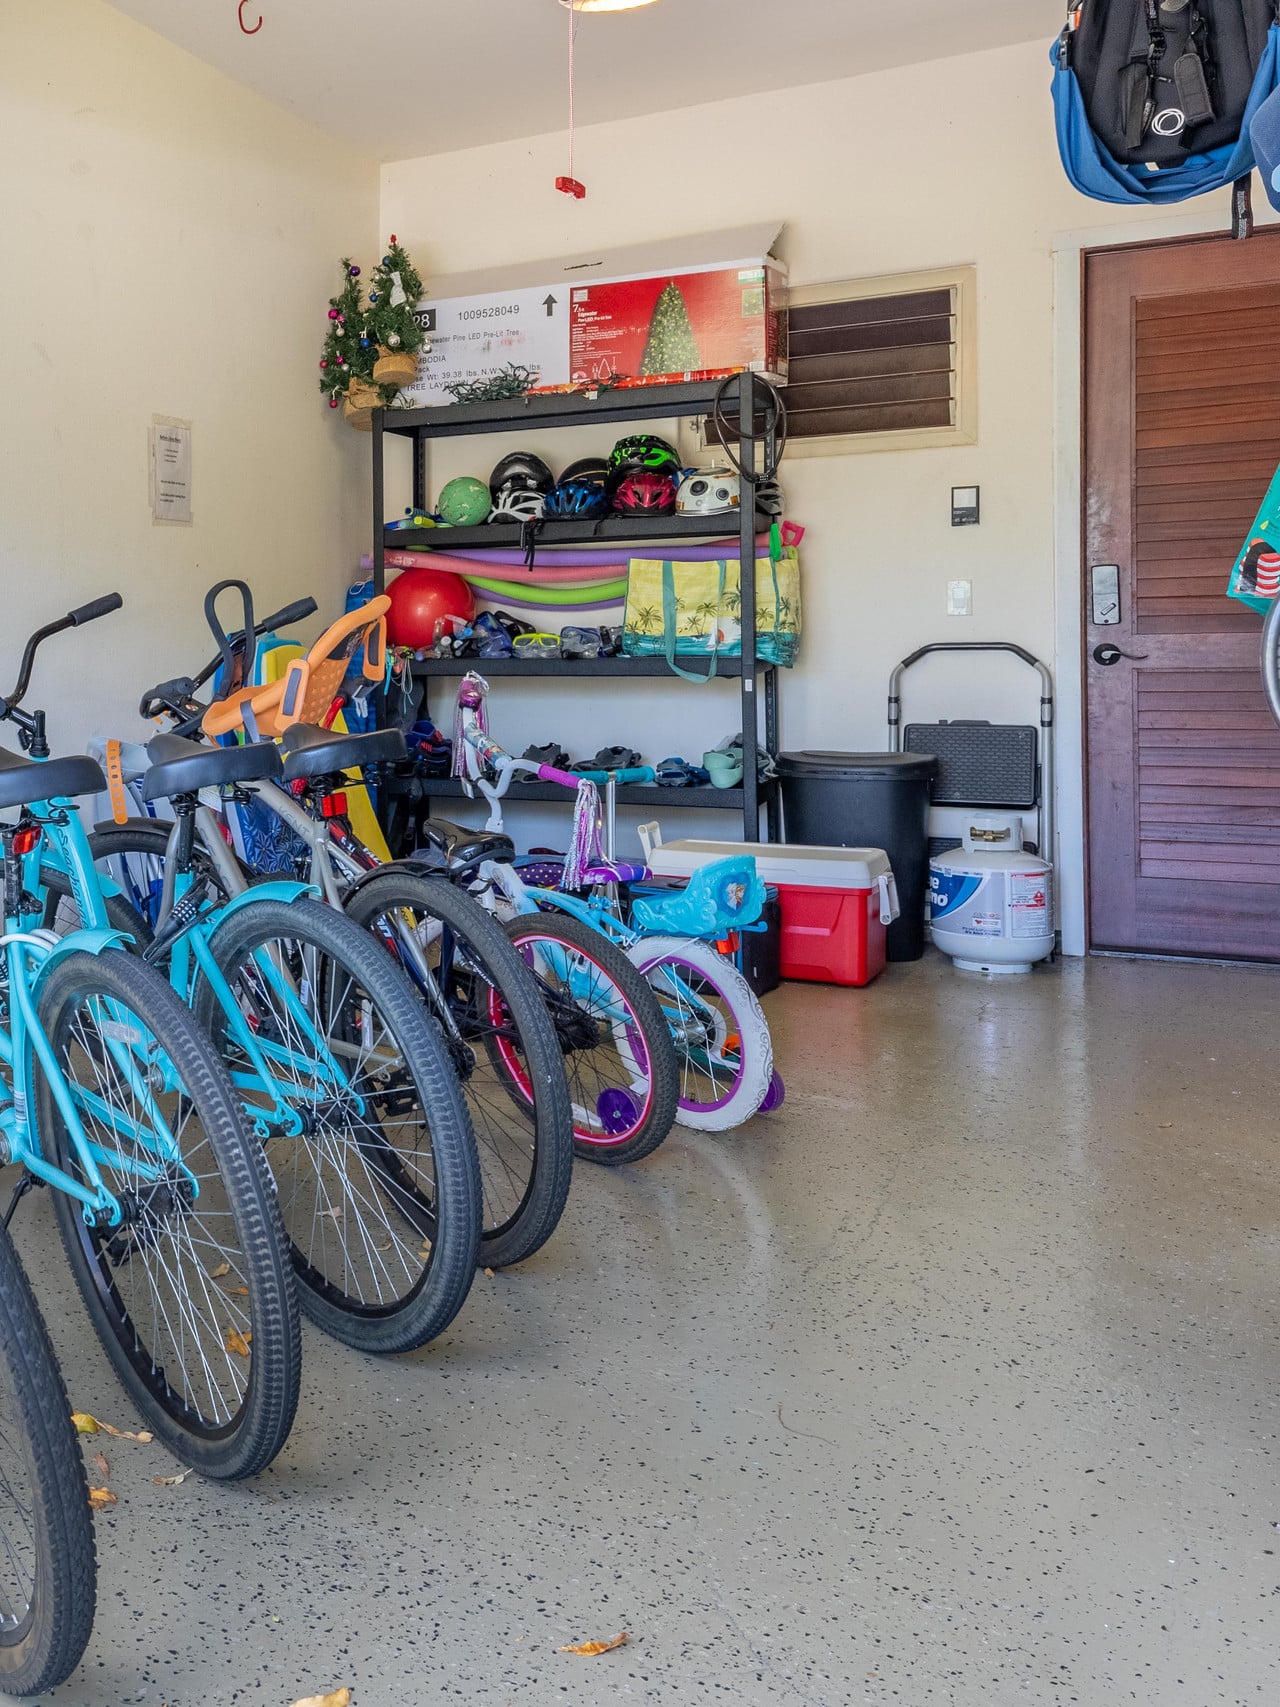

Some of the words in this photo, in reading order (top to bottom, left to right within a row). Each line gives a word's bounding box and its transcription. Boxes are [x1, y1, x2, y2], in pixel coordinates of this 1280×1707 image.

[458, 304, 520, 321] 1009528049
[452, 334, 466, 342] Pine
[468, 332, 481, 340] LED
[442, 370, 463, 379] 39.38
[529, 363, 544, 371] lbs.
[406, 383, 426, 391] TREE
